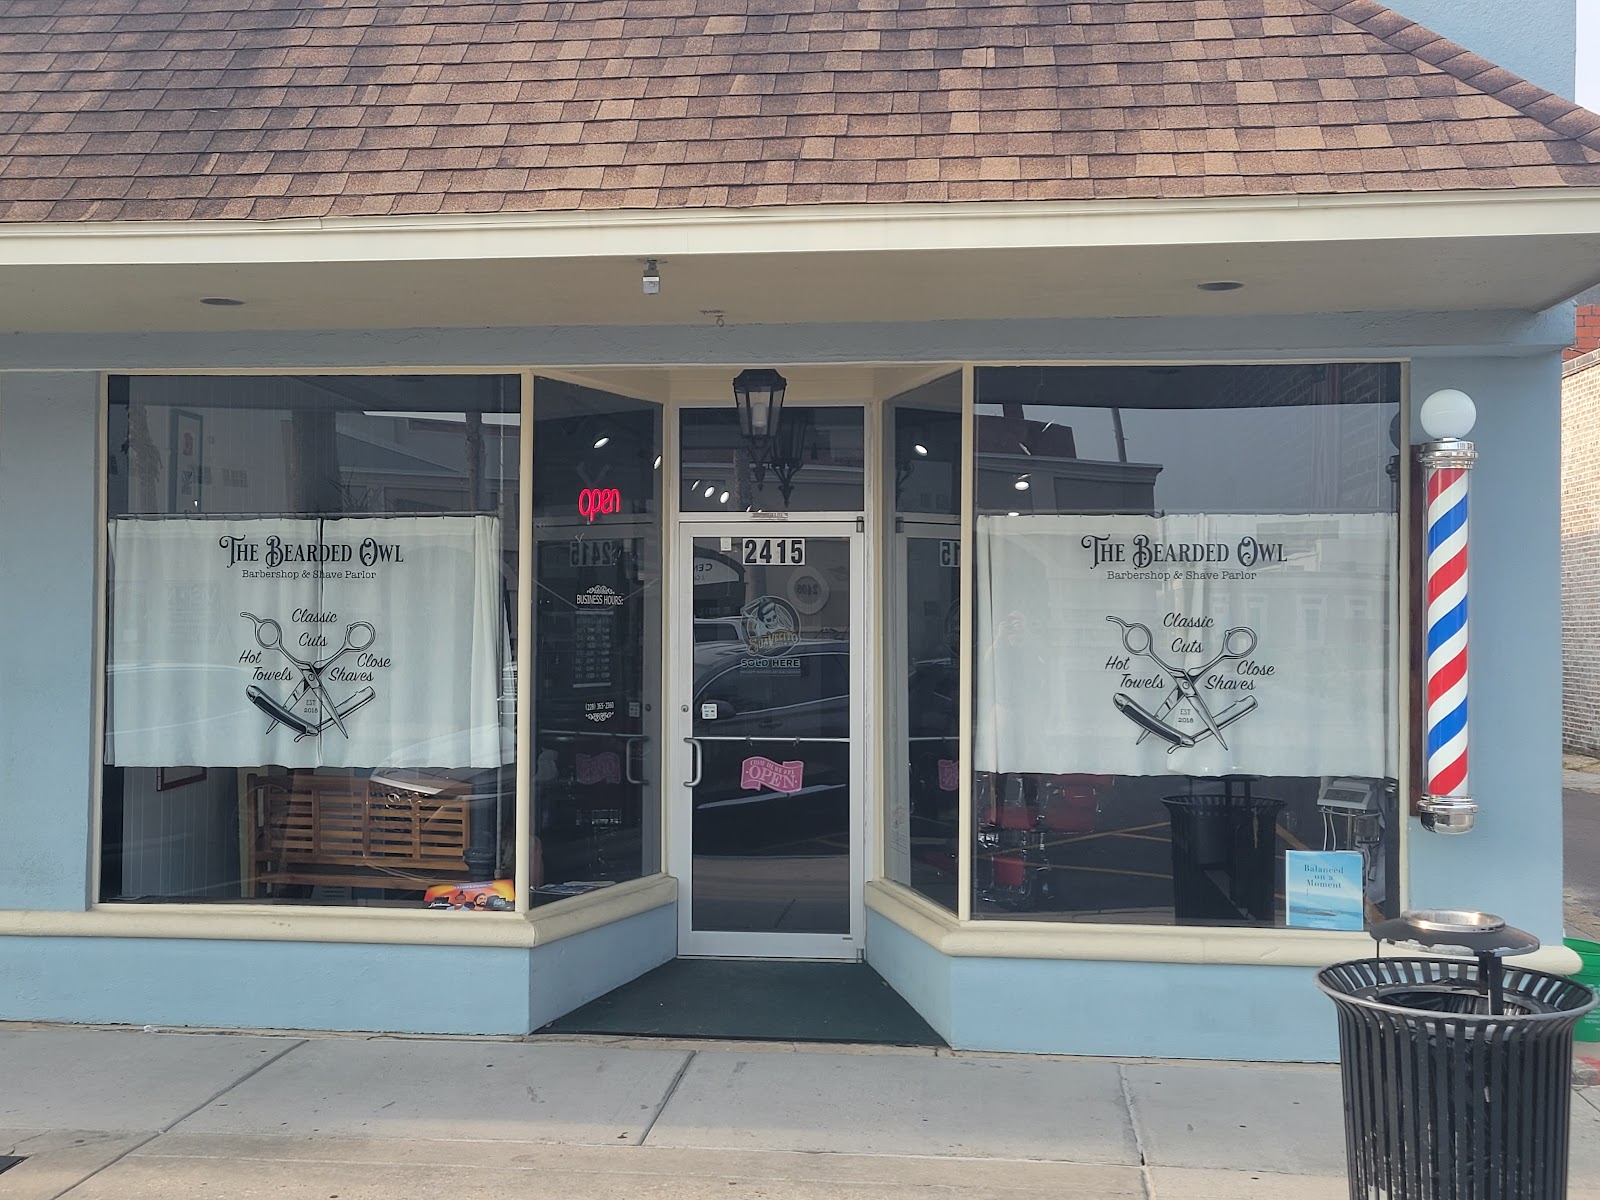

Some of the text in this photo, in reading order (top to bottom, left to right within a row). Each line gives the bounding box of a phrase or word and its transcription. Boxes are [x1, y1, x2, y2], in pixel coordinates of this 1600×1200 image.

[744, 539, 803, 564] 2415
[242, 570, 376, 580] Barbershop & Shave Parlor
[1106, 570, 1256, 581] Barbershop & Shave Parlor
[576, 594, 603, 605] BUSINESS
[291, 608, 338, 623] Classic
[1163, 612, 1214, 628] Classic
[298, 632, 328, 647] Cuts
[1171, 638, 1204, 653] Cuts
[238, 650, 262, 664] Hot
[357, 653, 391, 668] Close
[741, 659, 800, 668] SOLD HERE
[1104, 656, 1130, 670] Hot
[252, 666, 294, 681] Towels
[328, 666, 374, 682] Shaves
[1236, 660, 1276, 676] Close
[1120, 673, 1166, 688] Towels
[1205, 674, 1256, 690] Shaves
[749, 765, 796, 789] OPEN
[1304, 865, 1344, 874] Balanced
[1306, 879, 1341, 888] Moment
